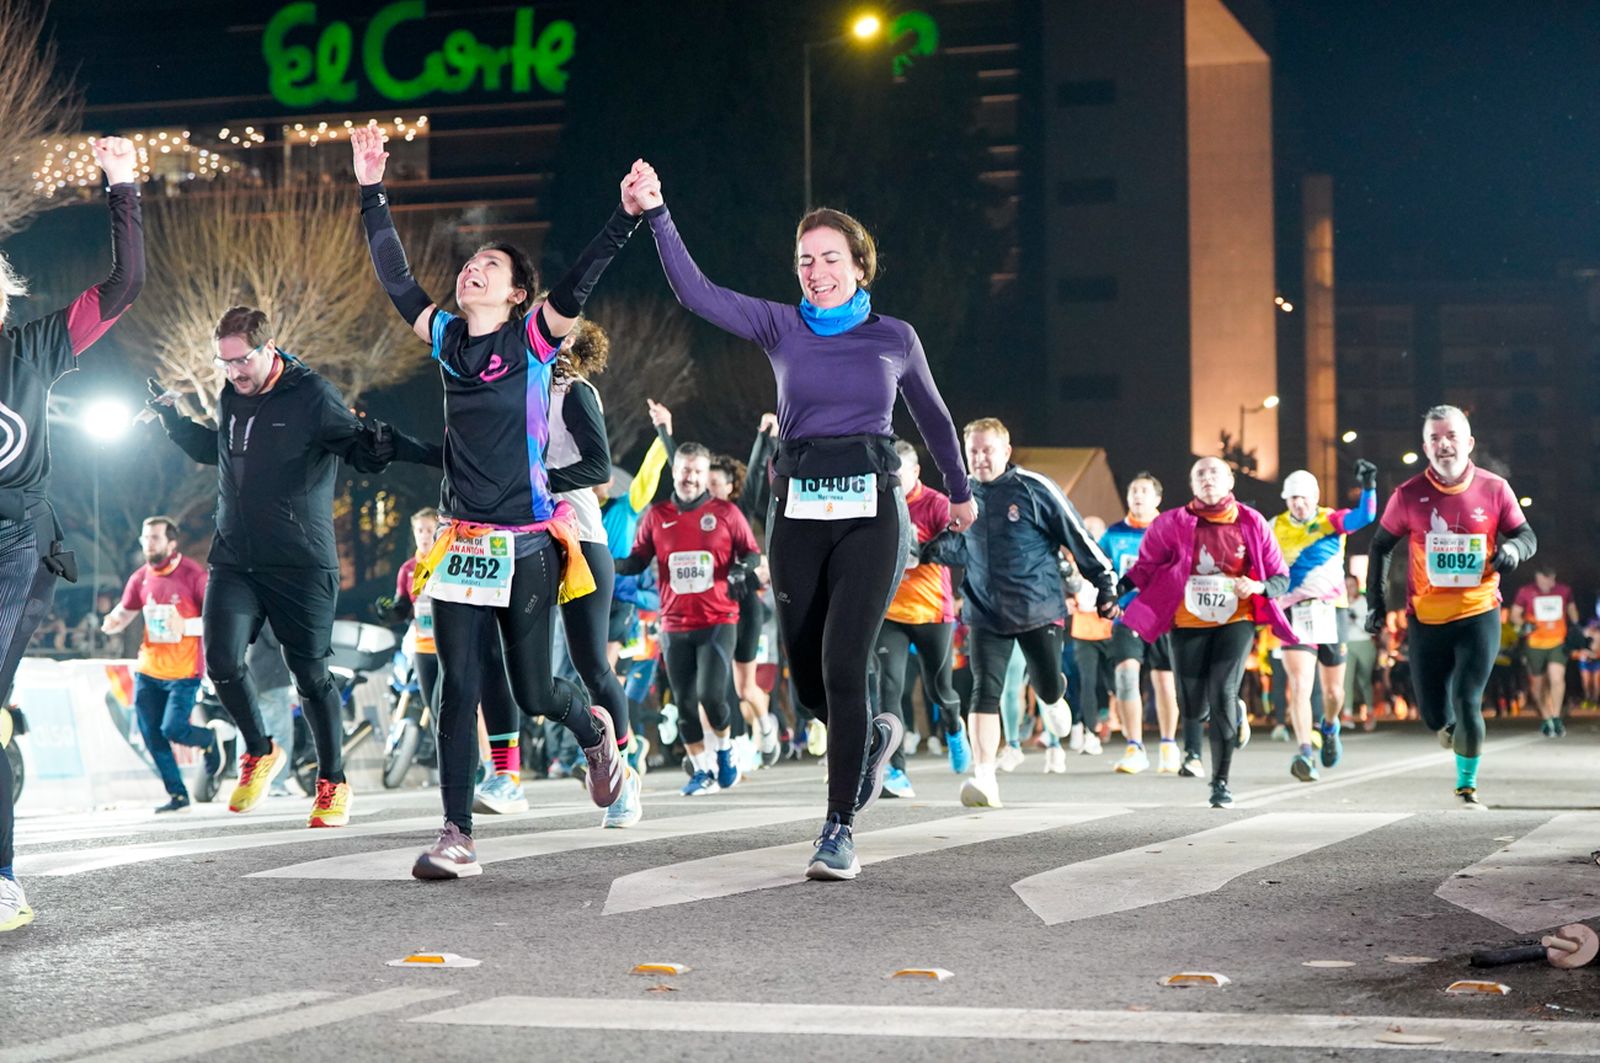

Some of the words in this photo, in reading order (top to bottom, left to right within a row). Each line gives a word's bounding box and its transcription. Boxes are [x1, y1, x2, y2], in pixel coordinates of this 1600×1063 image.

[263, 2, 357, 107] El
[363, 0, 577, 100] Corte
[448, 545, 460, 553] AN
[447, 554, 500, 580] 8452
[1437, 553, 1476, 569] 8092
[677, 566, 705, 579] 6084
[1197, 593, 1226, 607] 7672
